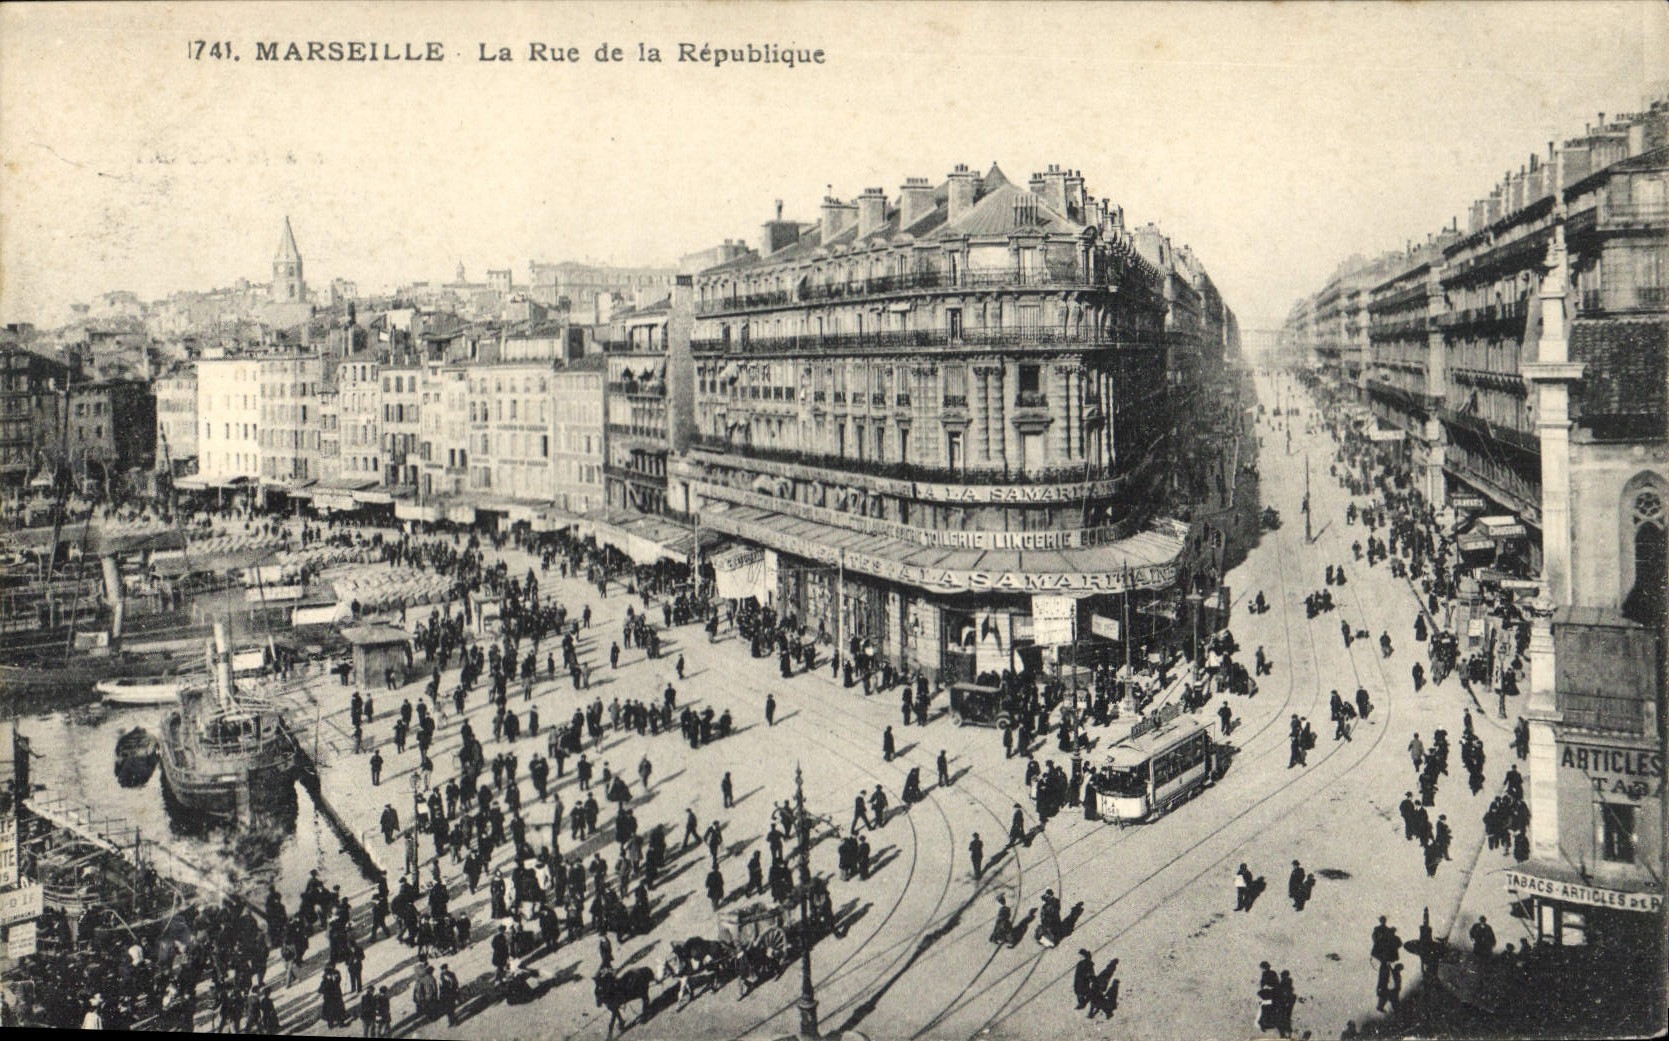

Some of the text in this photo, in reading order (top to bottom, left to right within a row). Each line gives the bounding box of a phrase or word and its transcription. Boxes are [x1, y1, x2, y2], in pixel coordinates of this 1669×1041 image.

[993, 532, 1072, 549] LINGERIE
[1561, 745, 1664, 778] ARTICLES
[1507, 873, 1553, 895] TABACS
[1561, 884, 1625, 908] ARTICLES
